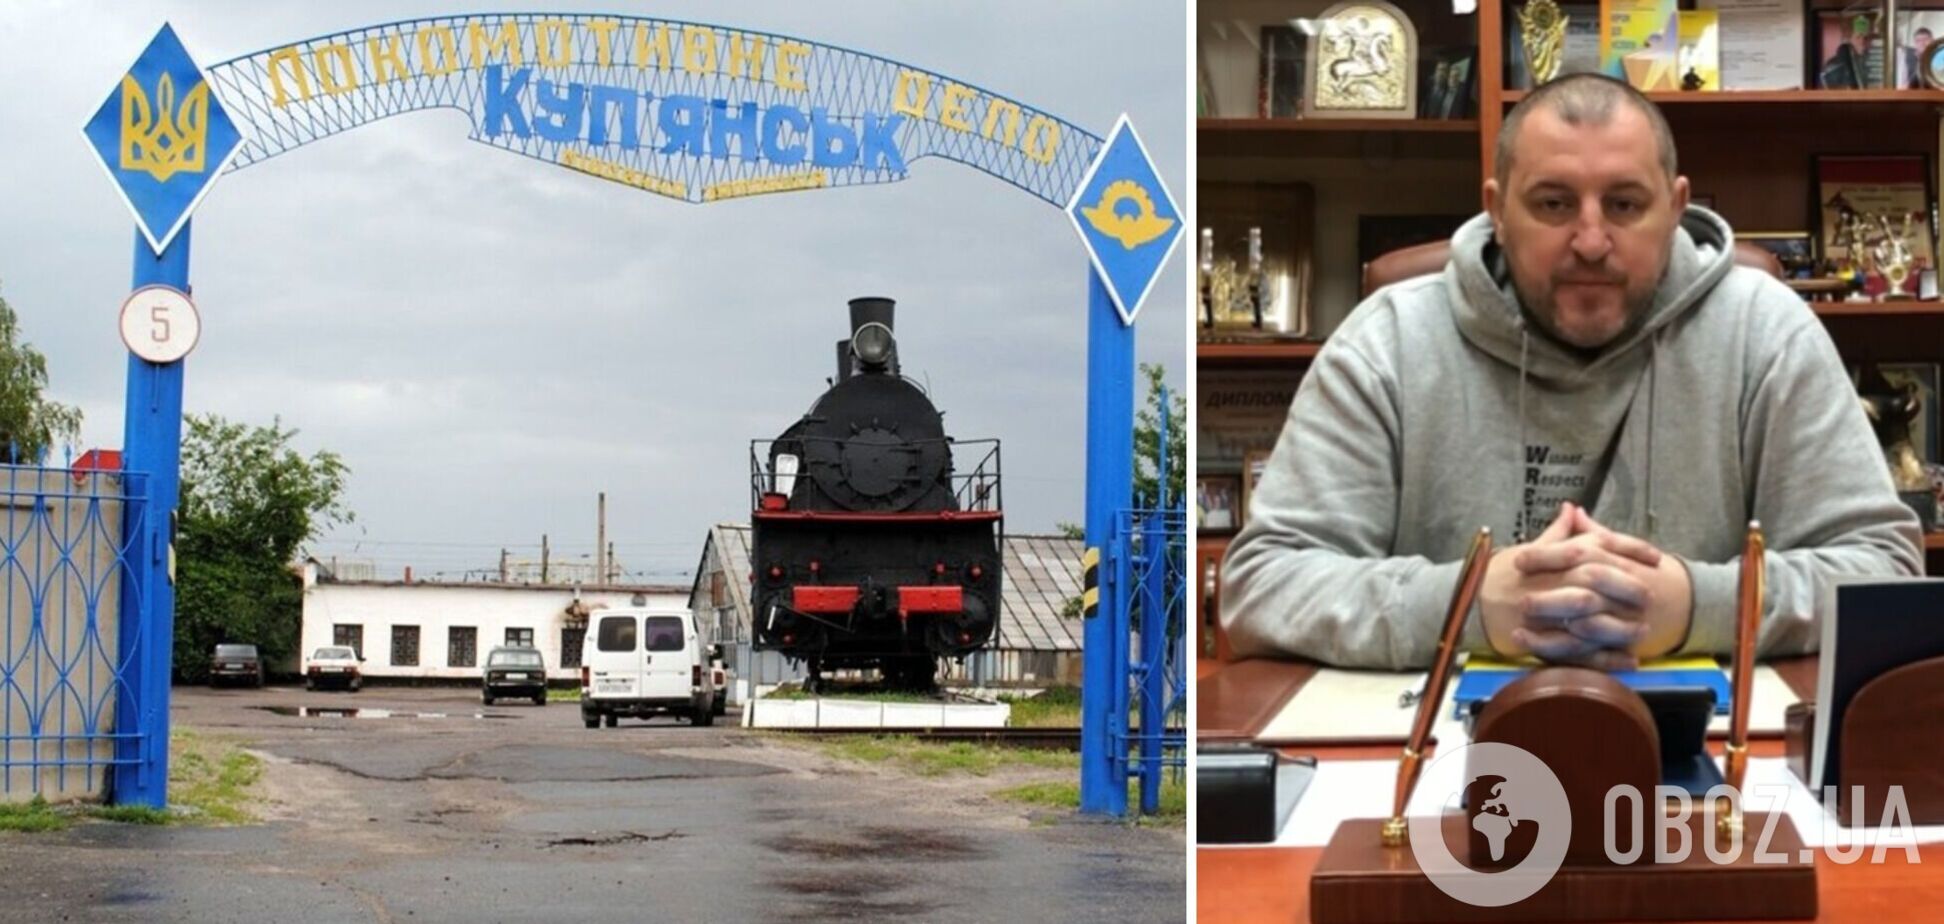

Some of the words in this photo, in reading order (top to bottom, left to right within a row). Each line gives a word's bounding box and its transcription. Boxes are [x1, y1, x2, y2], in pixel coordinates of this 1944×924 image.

[267, 17, 811, 108] ЛОКОМОТИВНЕ
[894, 69, 1062, 165] ДЕПО
[151, 306, 170, 342] 5
[1526, 446, 1582, 464] Winner
[1525, 467, 1585, 487] Respect
